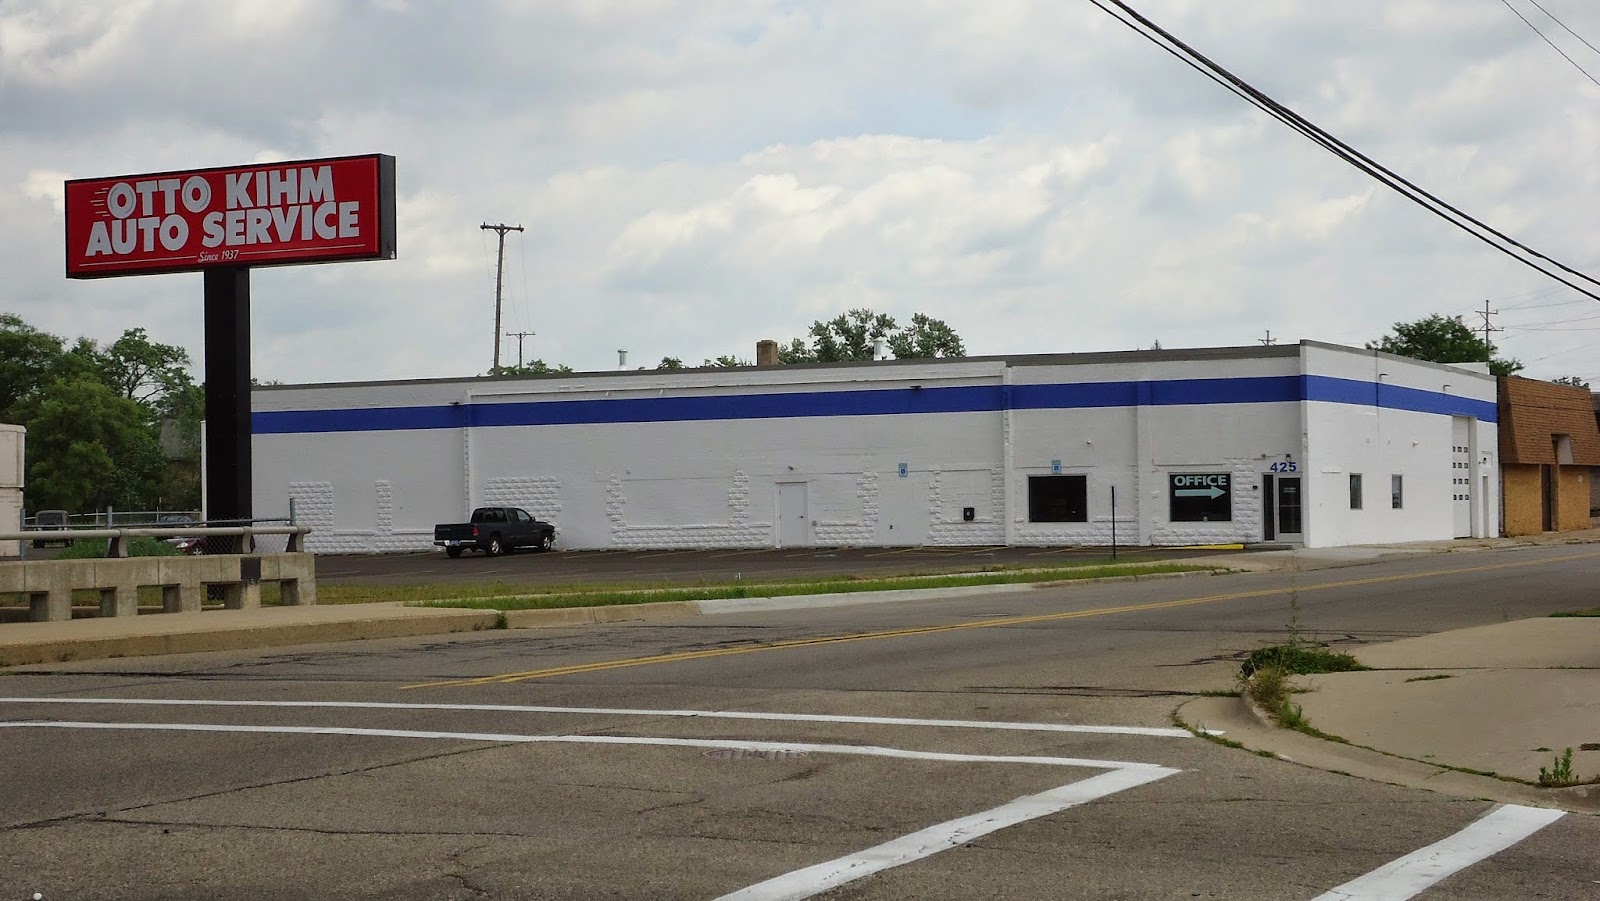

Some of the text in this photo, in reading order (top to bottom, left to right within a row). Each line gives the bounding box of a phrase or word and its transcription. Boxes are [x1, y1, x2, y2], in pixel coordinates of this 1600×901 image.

[107, 165, 335, 219] OTTO KIHM
[85, 200, 360, 257] AUTO SERVICE
[198, 249, 240, 263] Since 1937
[1270, 461, 1297, 473] 425
[1174, 475, 1227, 486] OFFICE
